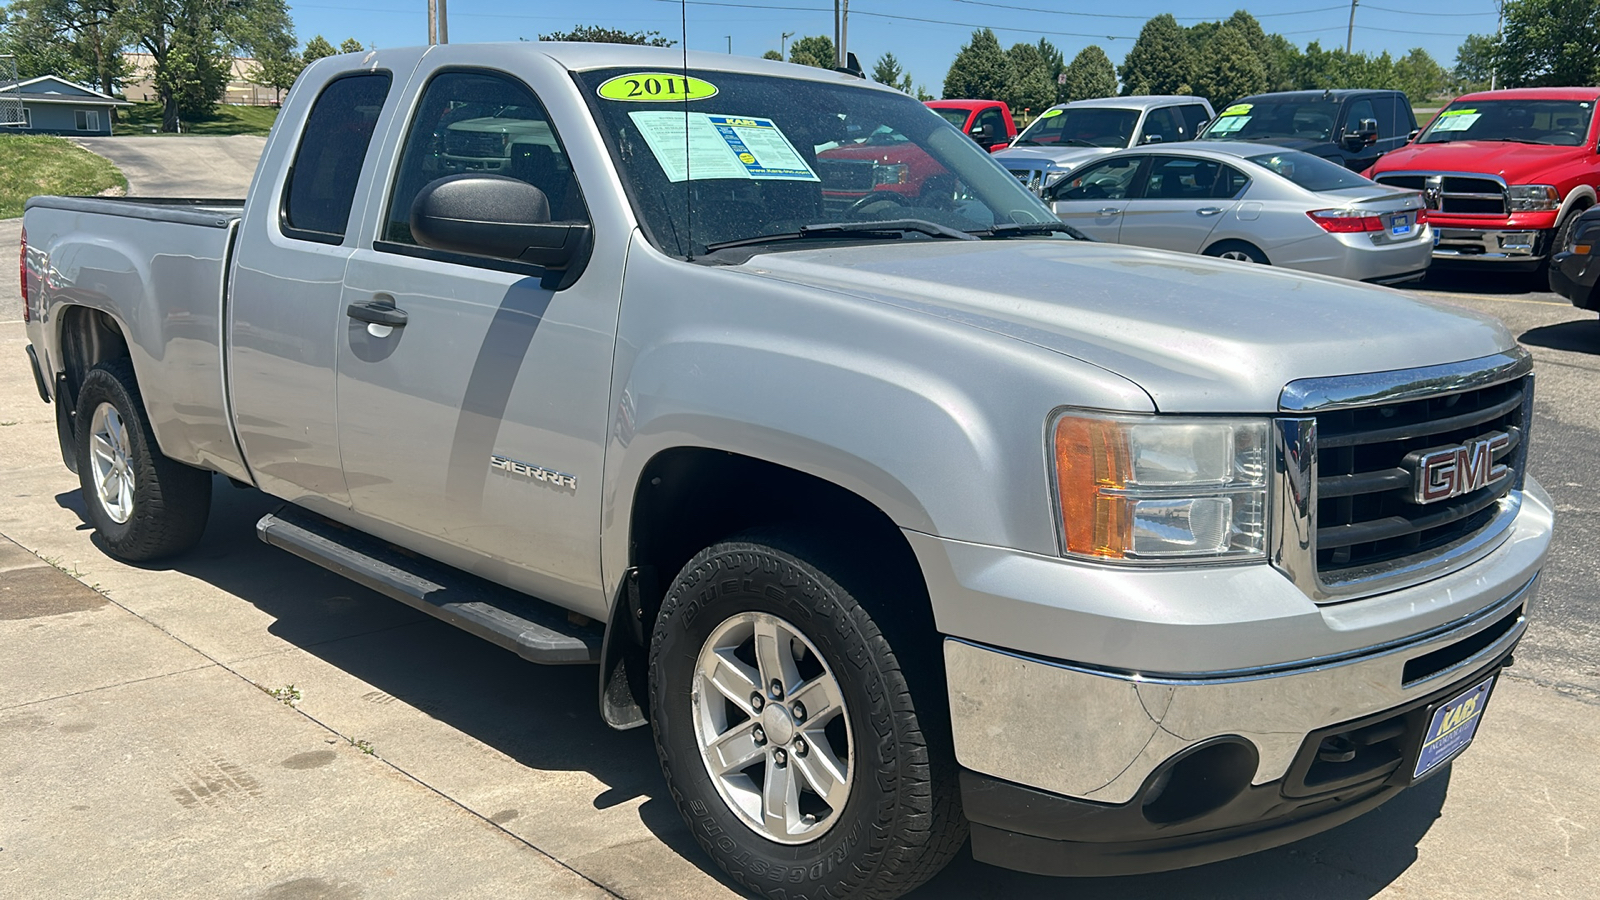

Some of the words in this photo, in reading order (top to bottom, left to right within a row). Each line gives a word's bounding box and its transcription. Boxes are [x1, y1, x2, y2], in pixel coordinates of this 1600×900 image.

[625, 78, 694, 97] 2011
[491, 455, 577, 489] SIERRA
[1415, 432, 1509, 504] GMC
[681, 578, 813, 630] DUELER
[688, 799, 863, 884] BRIDGESTONE
